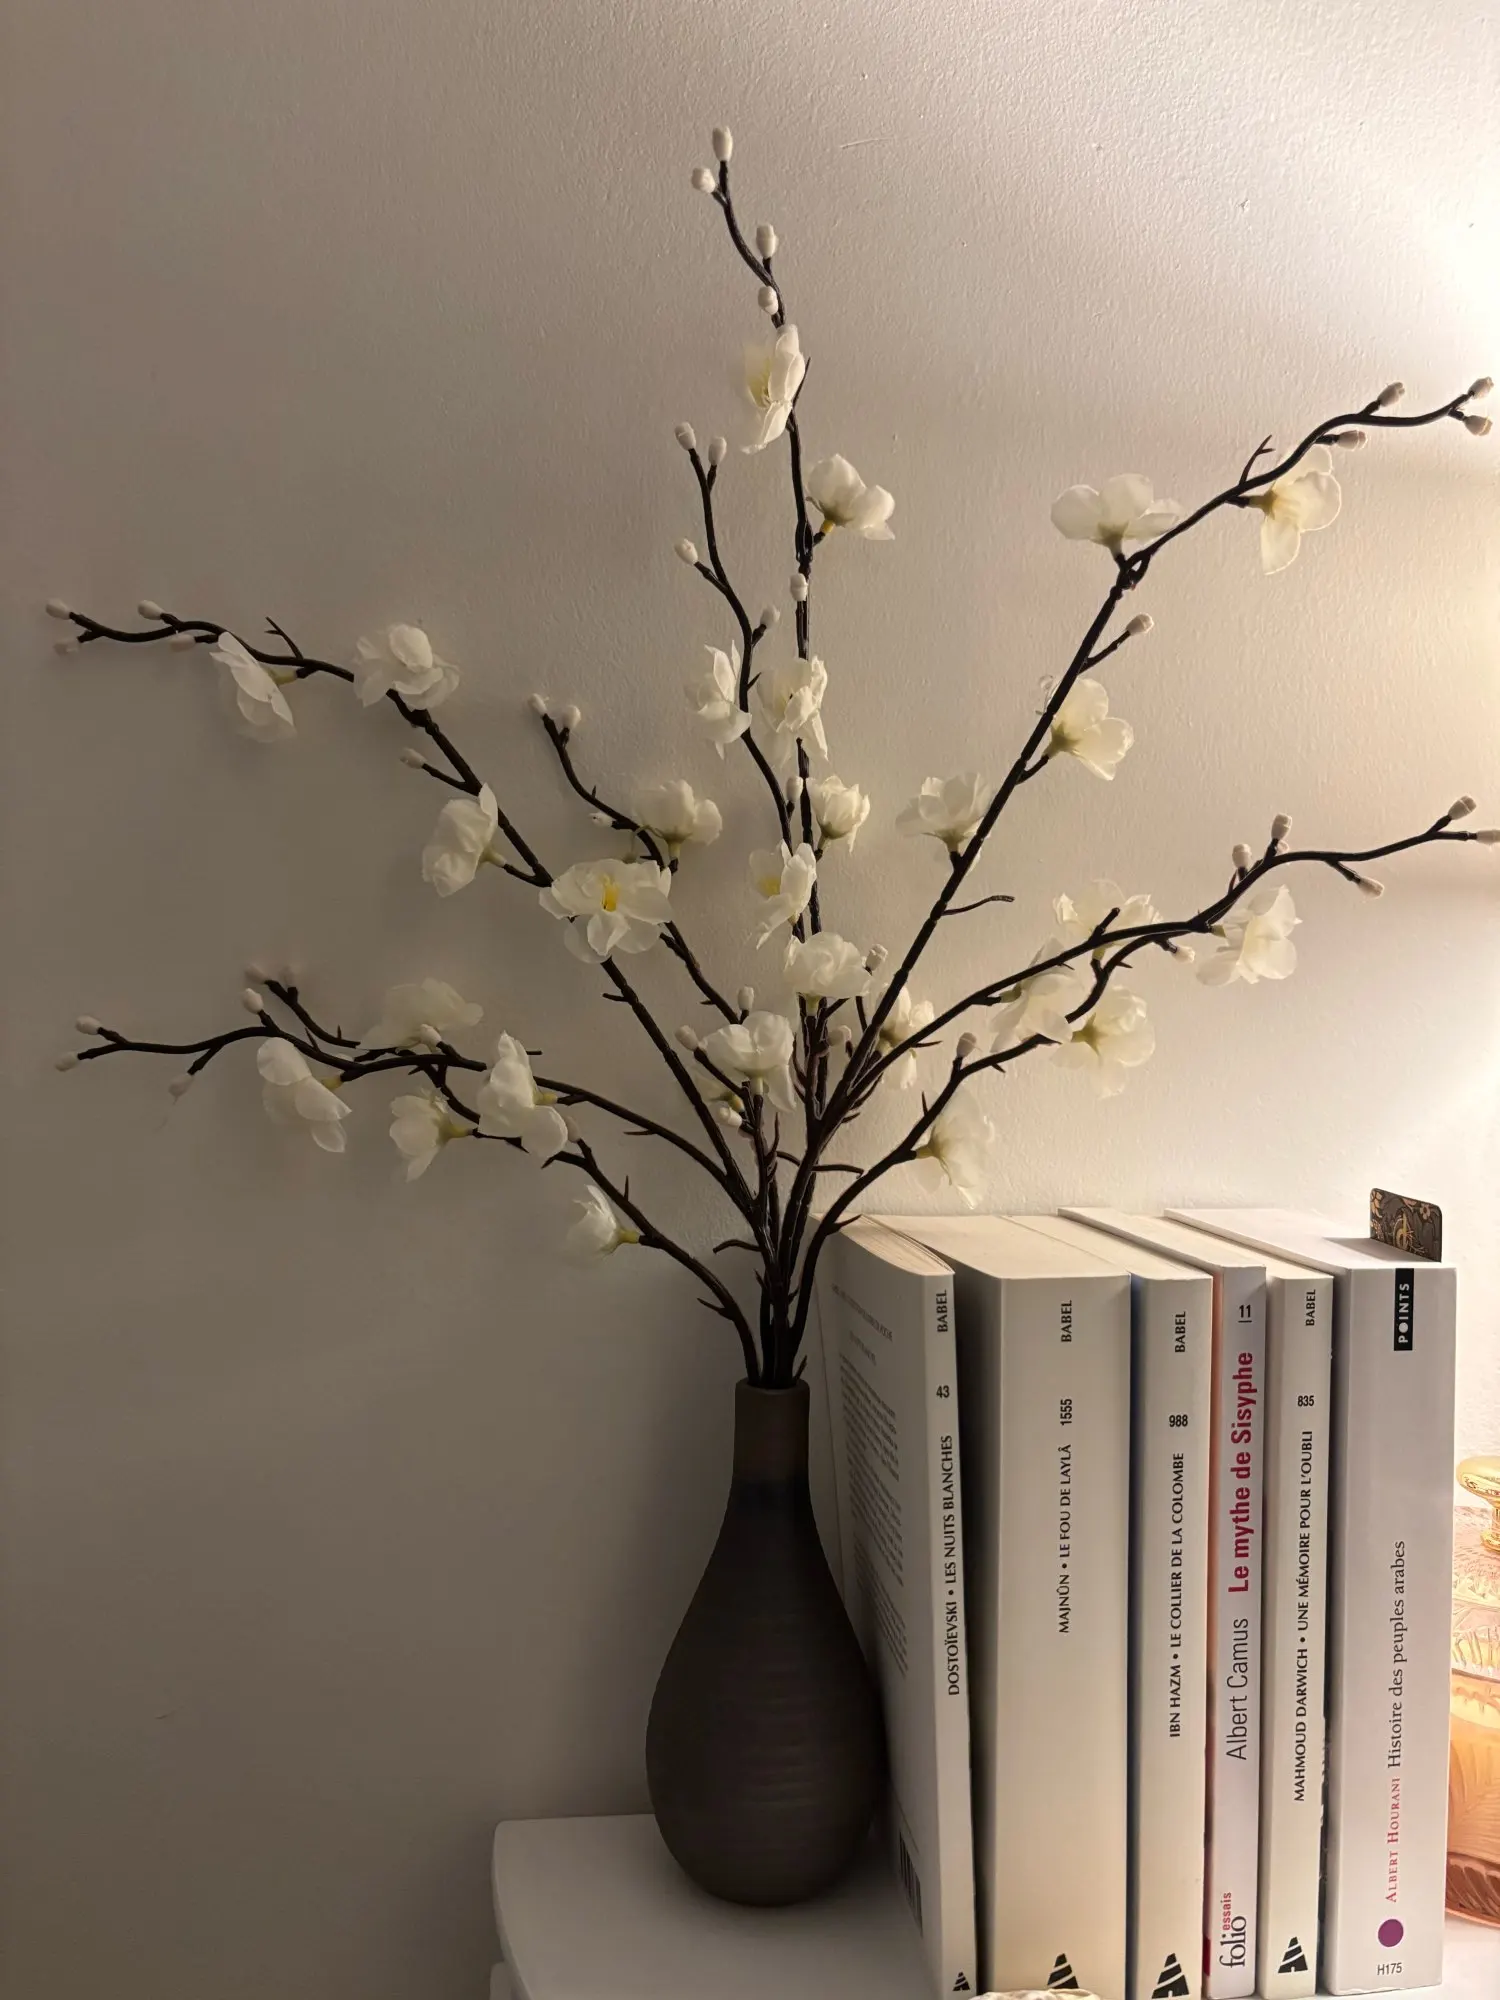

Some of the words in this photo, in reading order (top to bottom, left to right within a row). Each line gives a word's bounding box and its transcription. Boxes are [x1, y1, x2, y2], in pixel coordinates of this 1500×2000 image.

[936, 1289, 948, 1332] BABEL
[1060, 1299, 1073, 1343] BABEL
[1238, 1304, 1252, 1318] 11
[1305, 1289, 1316, 1327] BABEL
[1398, 1283, 1410, 1343] POINTS
[1174, 1310, 1186, 1353] BABEL
[936, 1385, 950, 1398] 43
[1059, 1398, 1073, 1426] 1555
[1230, 1352, 1258, 1444] Sisyphe
[1297, 1394, 1315, 1407] 835
[1168, 1413, 1189, 1428] 988
[940, 1435, 954, 1510] BLANCHES
[1057, 1444, 1072, 1485] LAYLÂ
[1230, 1451, 1251, 1479] de
[1300, 1430, 1313, 1485] L'OUBLI
[1059, 1488, 1072, 1507] DE
[1171, 1452, 1184, 1525] COLOMBE
[1299, 1488, 1312, 1529] POUR
[943, 1514, 956, 1558] NUITS
[1059, 1510, 1071, 1540] FOU
[1171, 1527, 1183, 1545] LA
[1229, 1487, 1255, 1558] mythe
[1059, 1543, 1071, 1558] LE
[1170, 1548, 1183, 1568] DE
[1295, 1532, 1311, 1598] MÉMOIRE
[1389, 1540, 1406, 1595] arabes
[944, 1561, 956, 1584] LES
[1228, 1565, 1250, 1593] Le
[1055, 1574, 1072, 1634] MAJNÛN
[1170, 1570, 1183, 1630] COLLIER
[1297, 1601, 1309, 1632] UNE
[944, 1601, 960, 1696] DOSTOÏEVSKI
[1169, 1633, 1182, 1648] LE
[1226, 1618, 1249, 1689] Camus
[1389, 1599, 1409, 1665] peuples
[1169, 1664, 1182, 1708] HAZM
[1295, 1648, 1308, 1718] DARWICH
[1388, 1668, 1403, 1697] des
[1169, 1712, 1181, 1738] IBN
[1225, 1695, 1248, 1761] Albert
[1387, 1701, 1403, 1769] Histoire
[1293, 1721, 1307, 1802] MAHMOUD
[1220, 1892, 1232, 1931] essais
[1219, 1915, 1247, 1968] folio
[1377, 1961, 1403, 1976] H175
